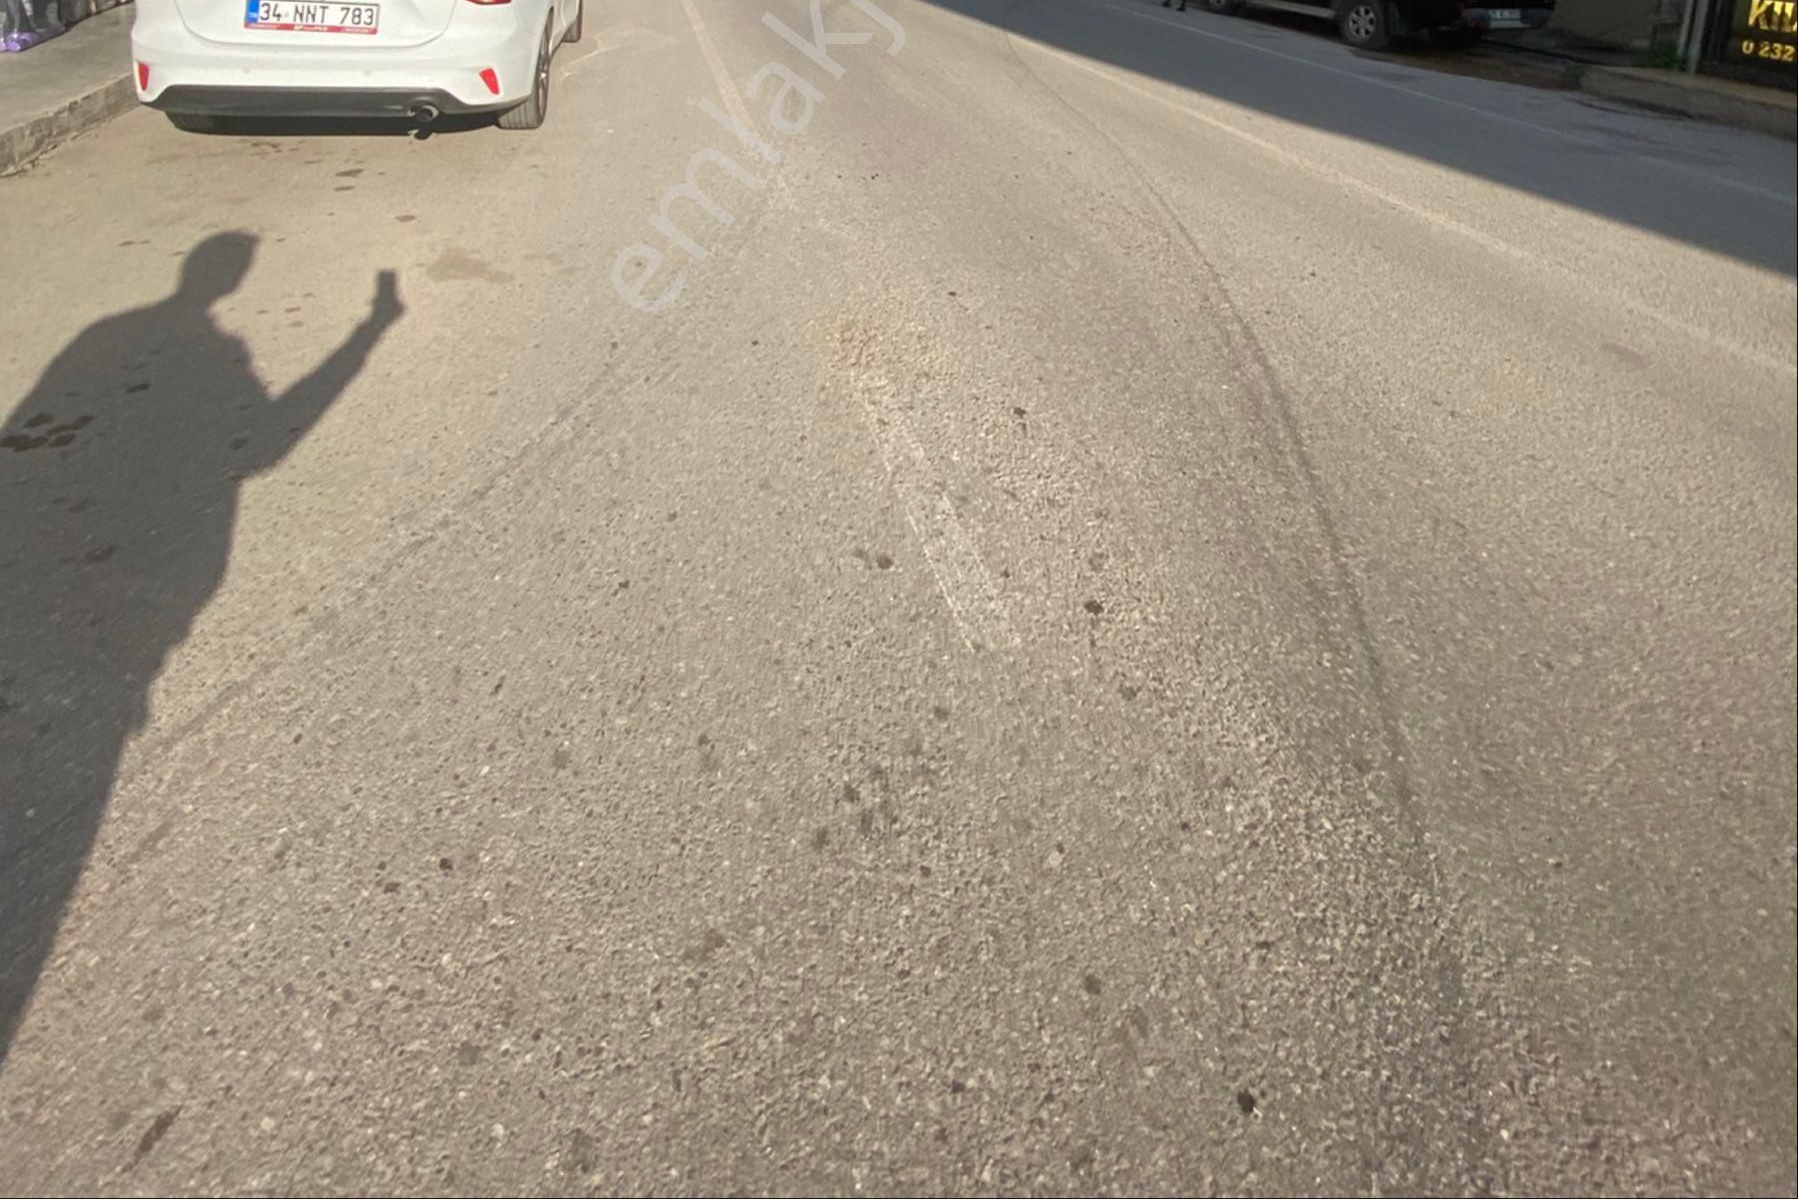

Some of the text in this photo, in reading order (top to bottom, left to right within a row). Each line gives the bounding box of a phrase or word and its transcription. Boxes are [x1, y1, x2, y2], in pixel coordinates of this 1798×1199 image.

[260, 2, 374, 26] 34 NNT 783
[1758, 41, 1796, 61] 232
